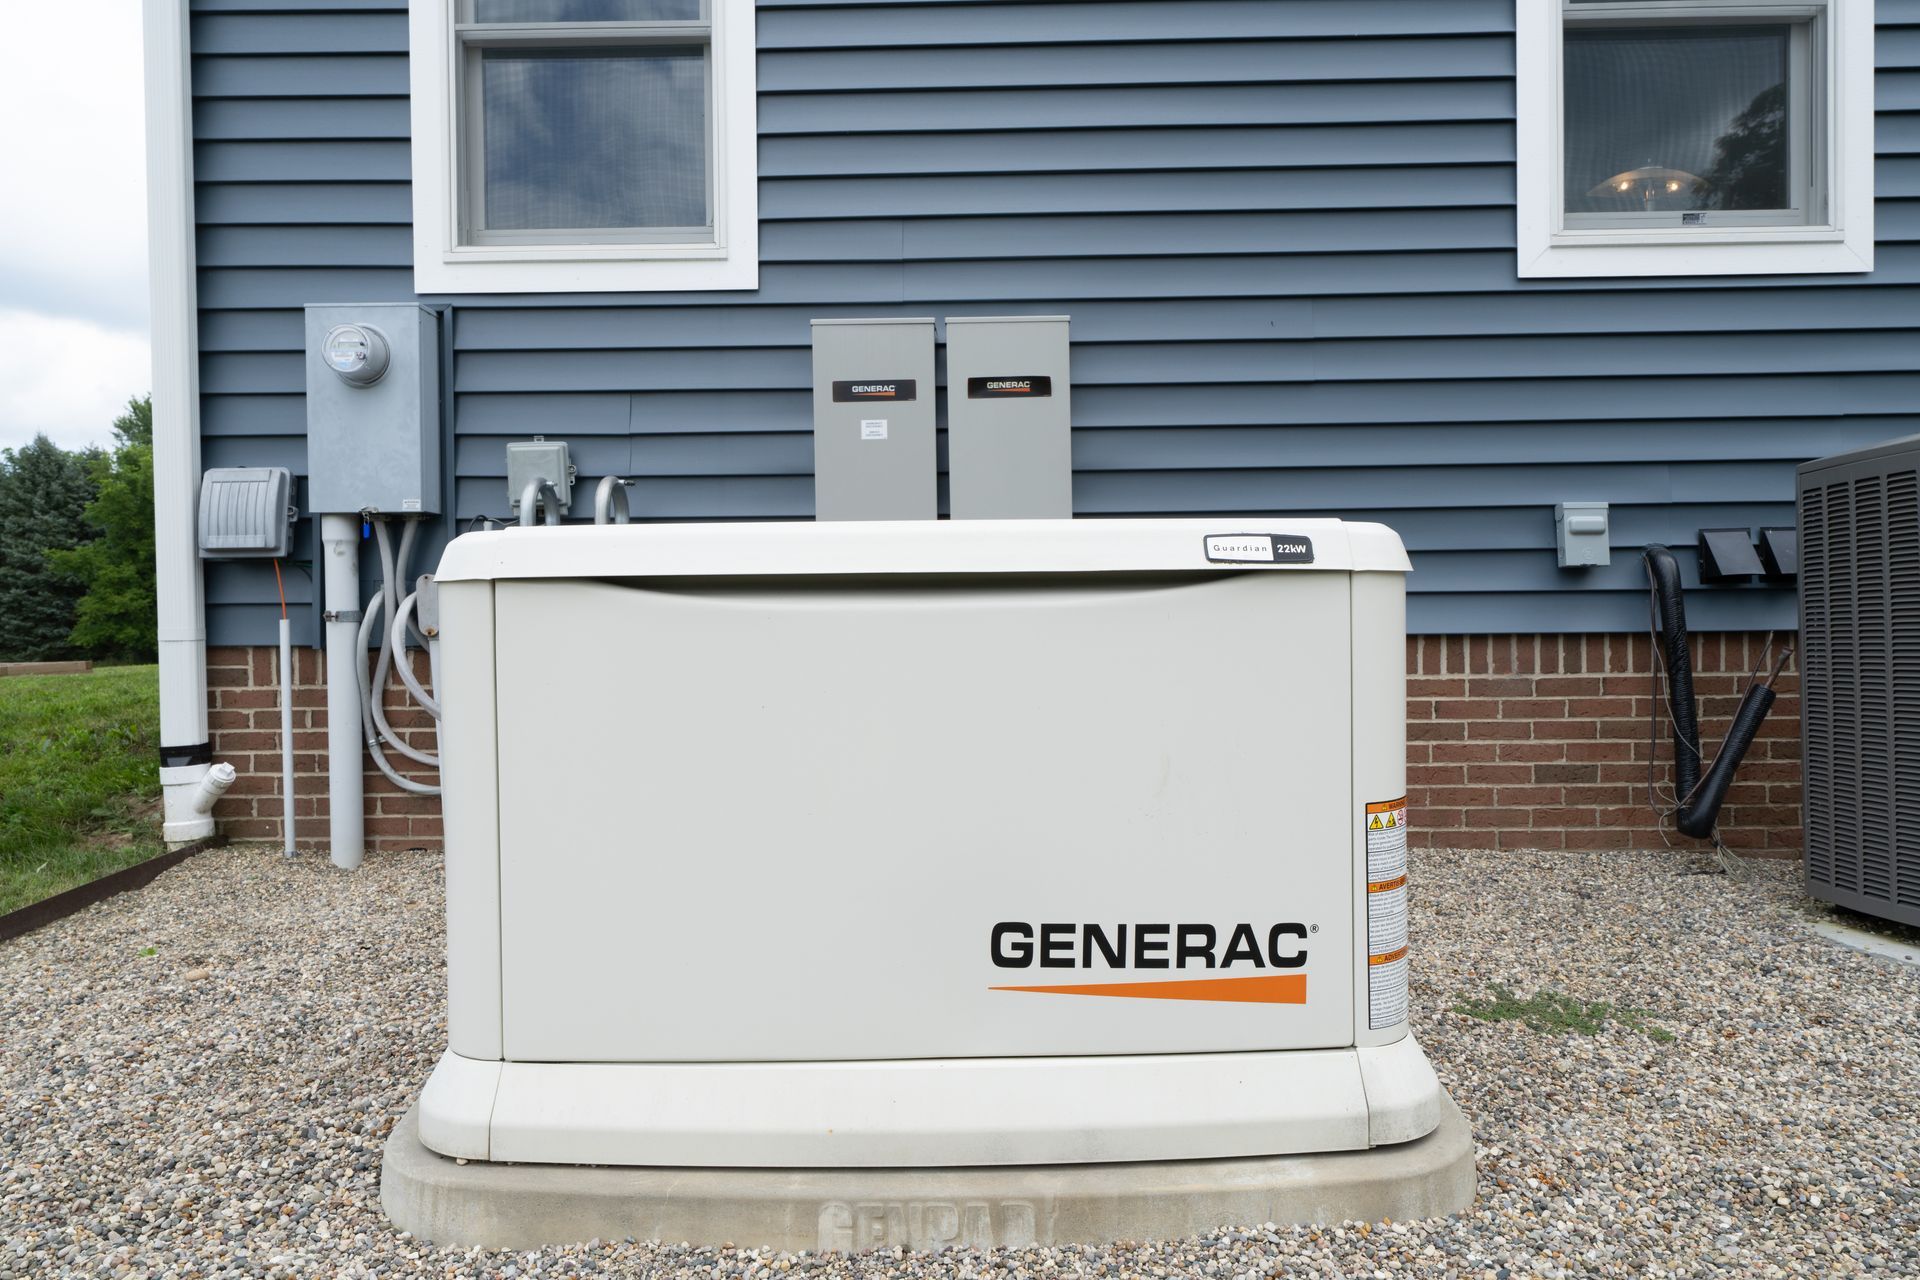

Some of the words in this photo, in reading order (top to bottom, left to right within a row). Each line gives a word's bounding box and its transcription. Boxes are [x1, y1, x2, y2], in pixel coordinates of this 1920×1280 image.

[851, 384, 896, 393] GENERAC
[986, 381, 1031, 389] GENERAC
[1213, 544, 1268, 552] Guardian
[1276, 543, 1307, 553] 22kW
